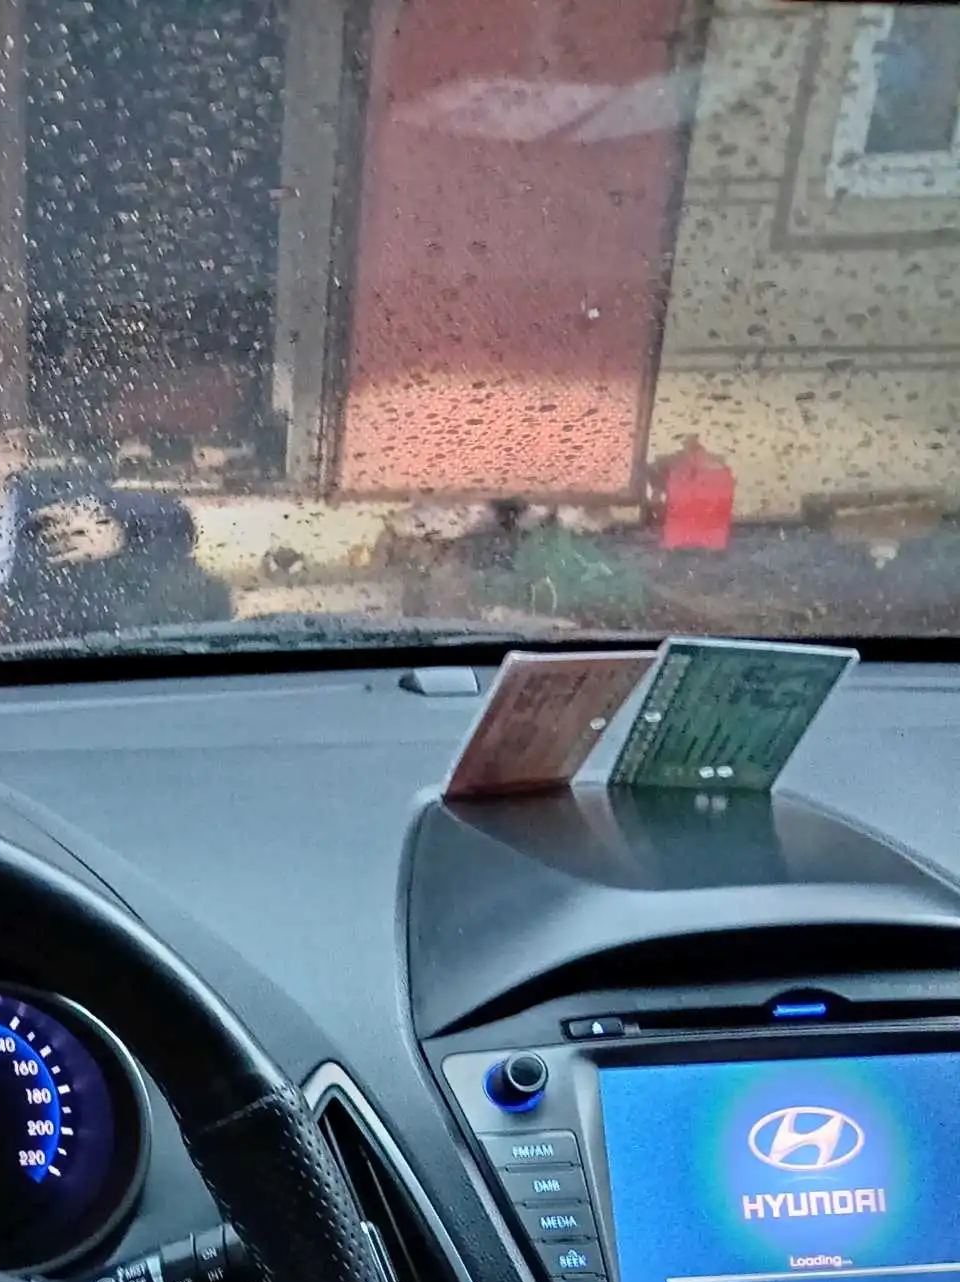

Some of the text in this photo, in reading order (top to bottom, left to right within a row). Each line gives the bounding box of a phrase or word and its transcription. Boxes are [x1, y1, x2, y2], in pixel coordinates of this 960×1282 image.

[12, 1059, 40, 1077] 160
[25, 1087, 52, 1105] 180
[26, 1120, 54, 1137] 200
[17, 1150, 46, 1167] 220
[533, 1179, 561, 1193] DMB
[741, 1187, 887, 1220] HYUNDAI
[541, 1215, 577, 1229] MEDIA
